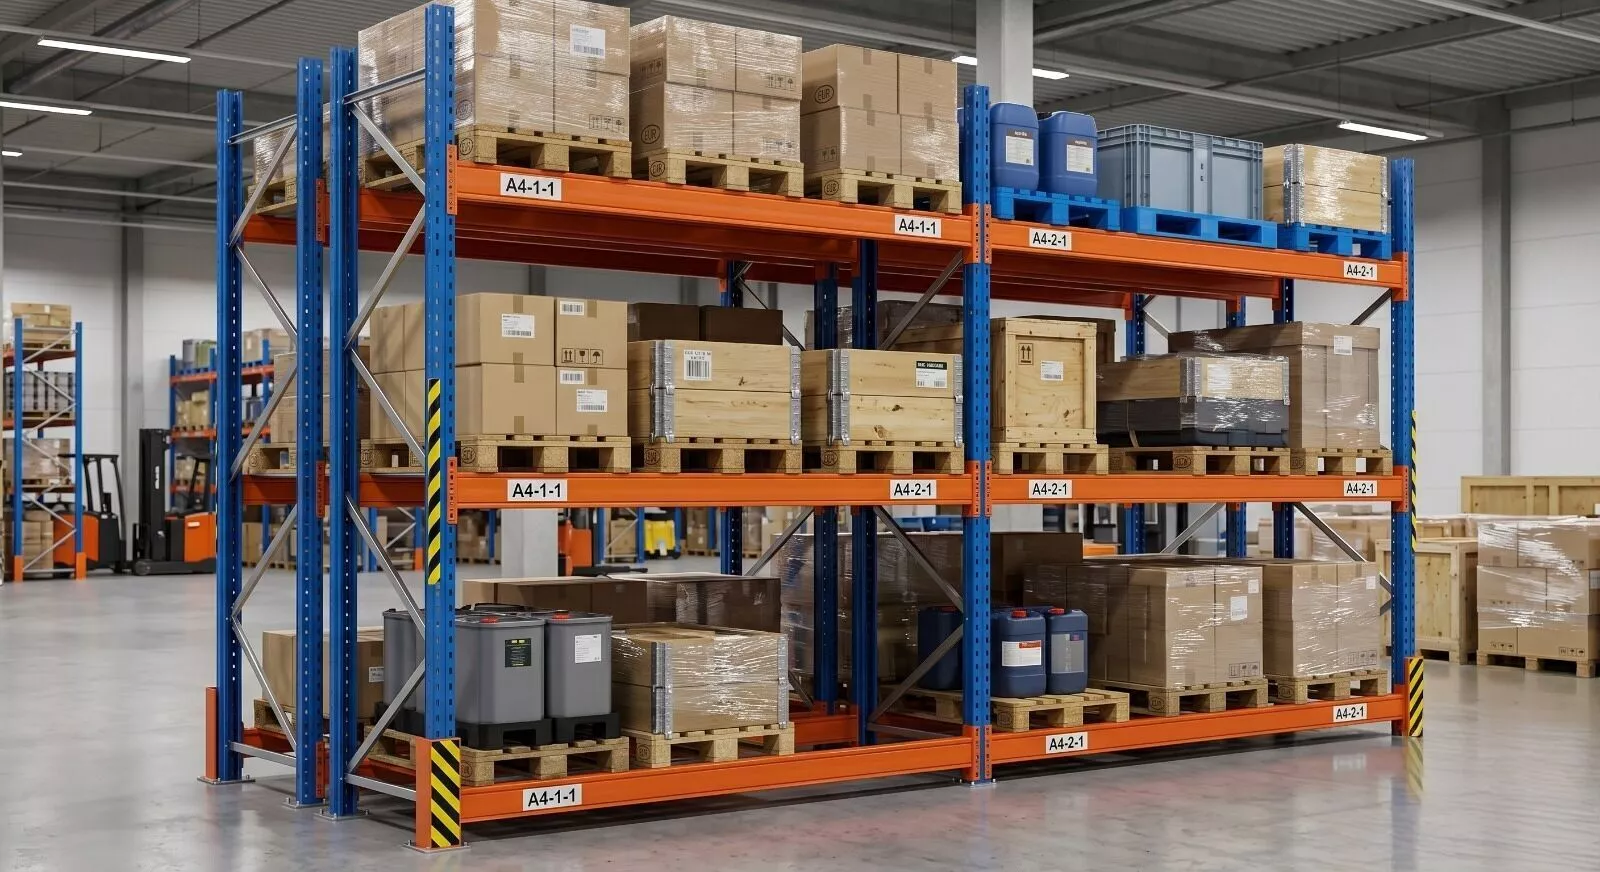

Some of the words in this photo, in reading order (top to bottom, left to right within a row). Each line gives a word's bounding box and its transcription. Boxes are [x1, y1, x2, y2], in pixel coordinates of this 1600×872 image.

[505, 177, 554, 197] A4-1-1
[898, 218, 936, 235] A4-1-1
[1032, 231, 1067, 247] A4-2-1
[1346, 264, 1374, 278] A4-2-1
[512, 482, 561, 498] A4-1-1
[893, 482, 931, 497] A4-2-1
[1032, 482, 1067, 496] A4-2-1
[1346, 482, 1374, 494] A4-2-1
[1336, 705, 1364, 720] A4-2-1
[1049, 735, 1084, 751] A4-2-1
[527, 787, 576, 807] A4-1-1
